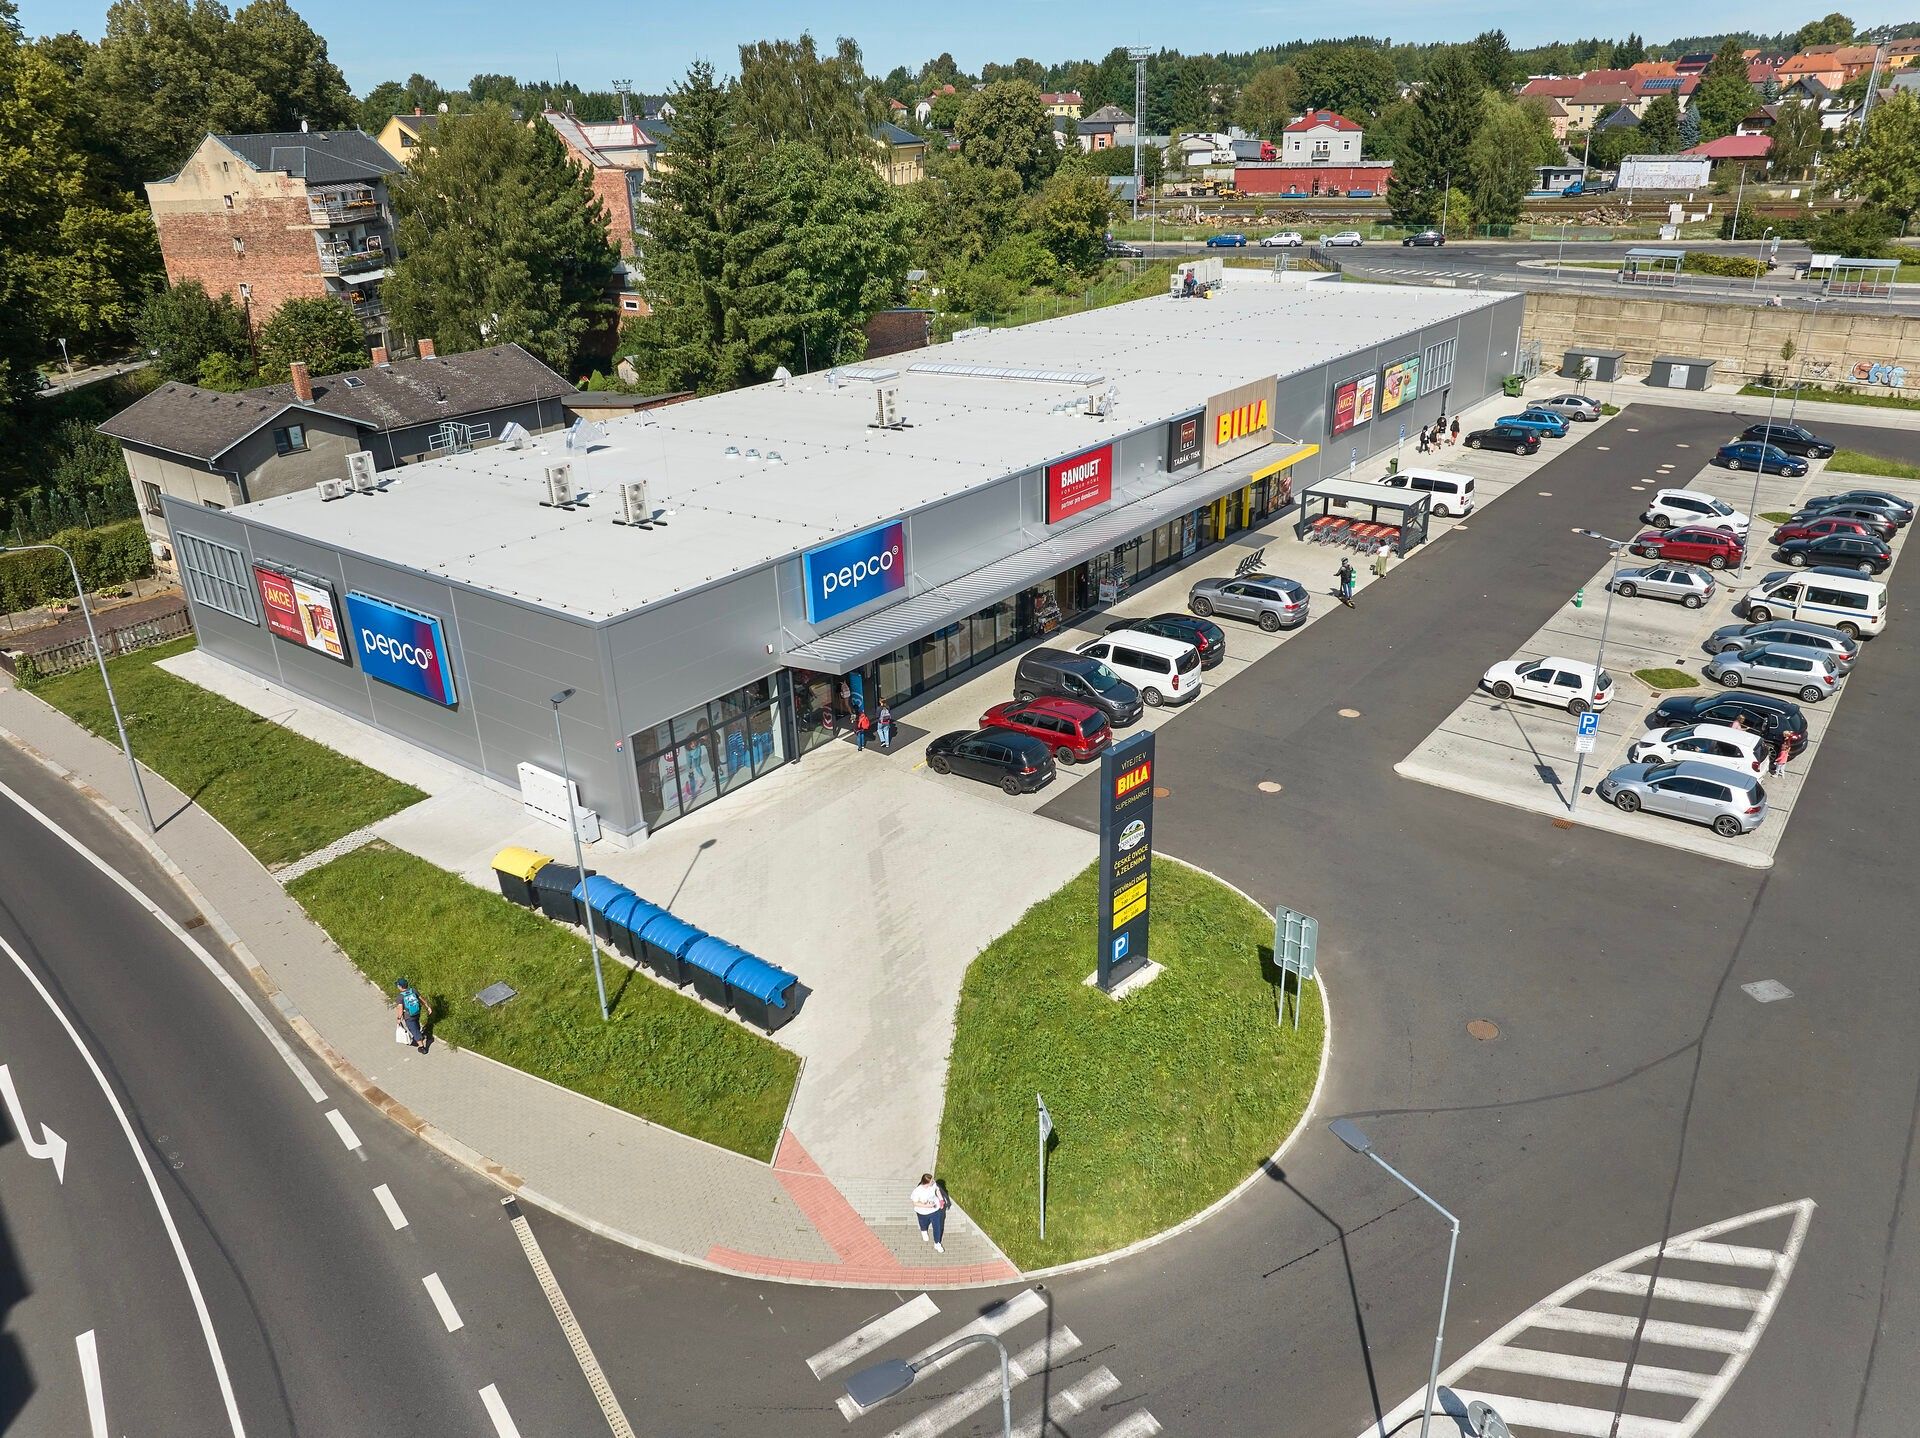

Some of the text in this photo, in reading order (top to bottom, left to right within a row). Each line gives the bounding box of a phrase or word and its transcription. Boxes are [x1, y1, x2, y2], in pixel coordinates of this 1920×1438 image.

[1216, 399, 1268, 446] BILLA
[1061, 459, 1100, 488] BANQUET
[268, 587, 292, 608] AKCE
[1582, 715, 1595, 729] P
[1117, 765, 1149, 795] BILLA
[1115, 787, 1150, 812] SUPERMARKET
[1114, 843, 1149, 870] ČESKÉ OVOCE
[1121, 855, 1146, 875] ZELENINA
[1135, 872, 1148, 884] DOBA
[1114, 936, 1126, 959] P
